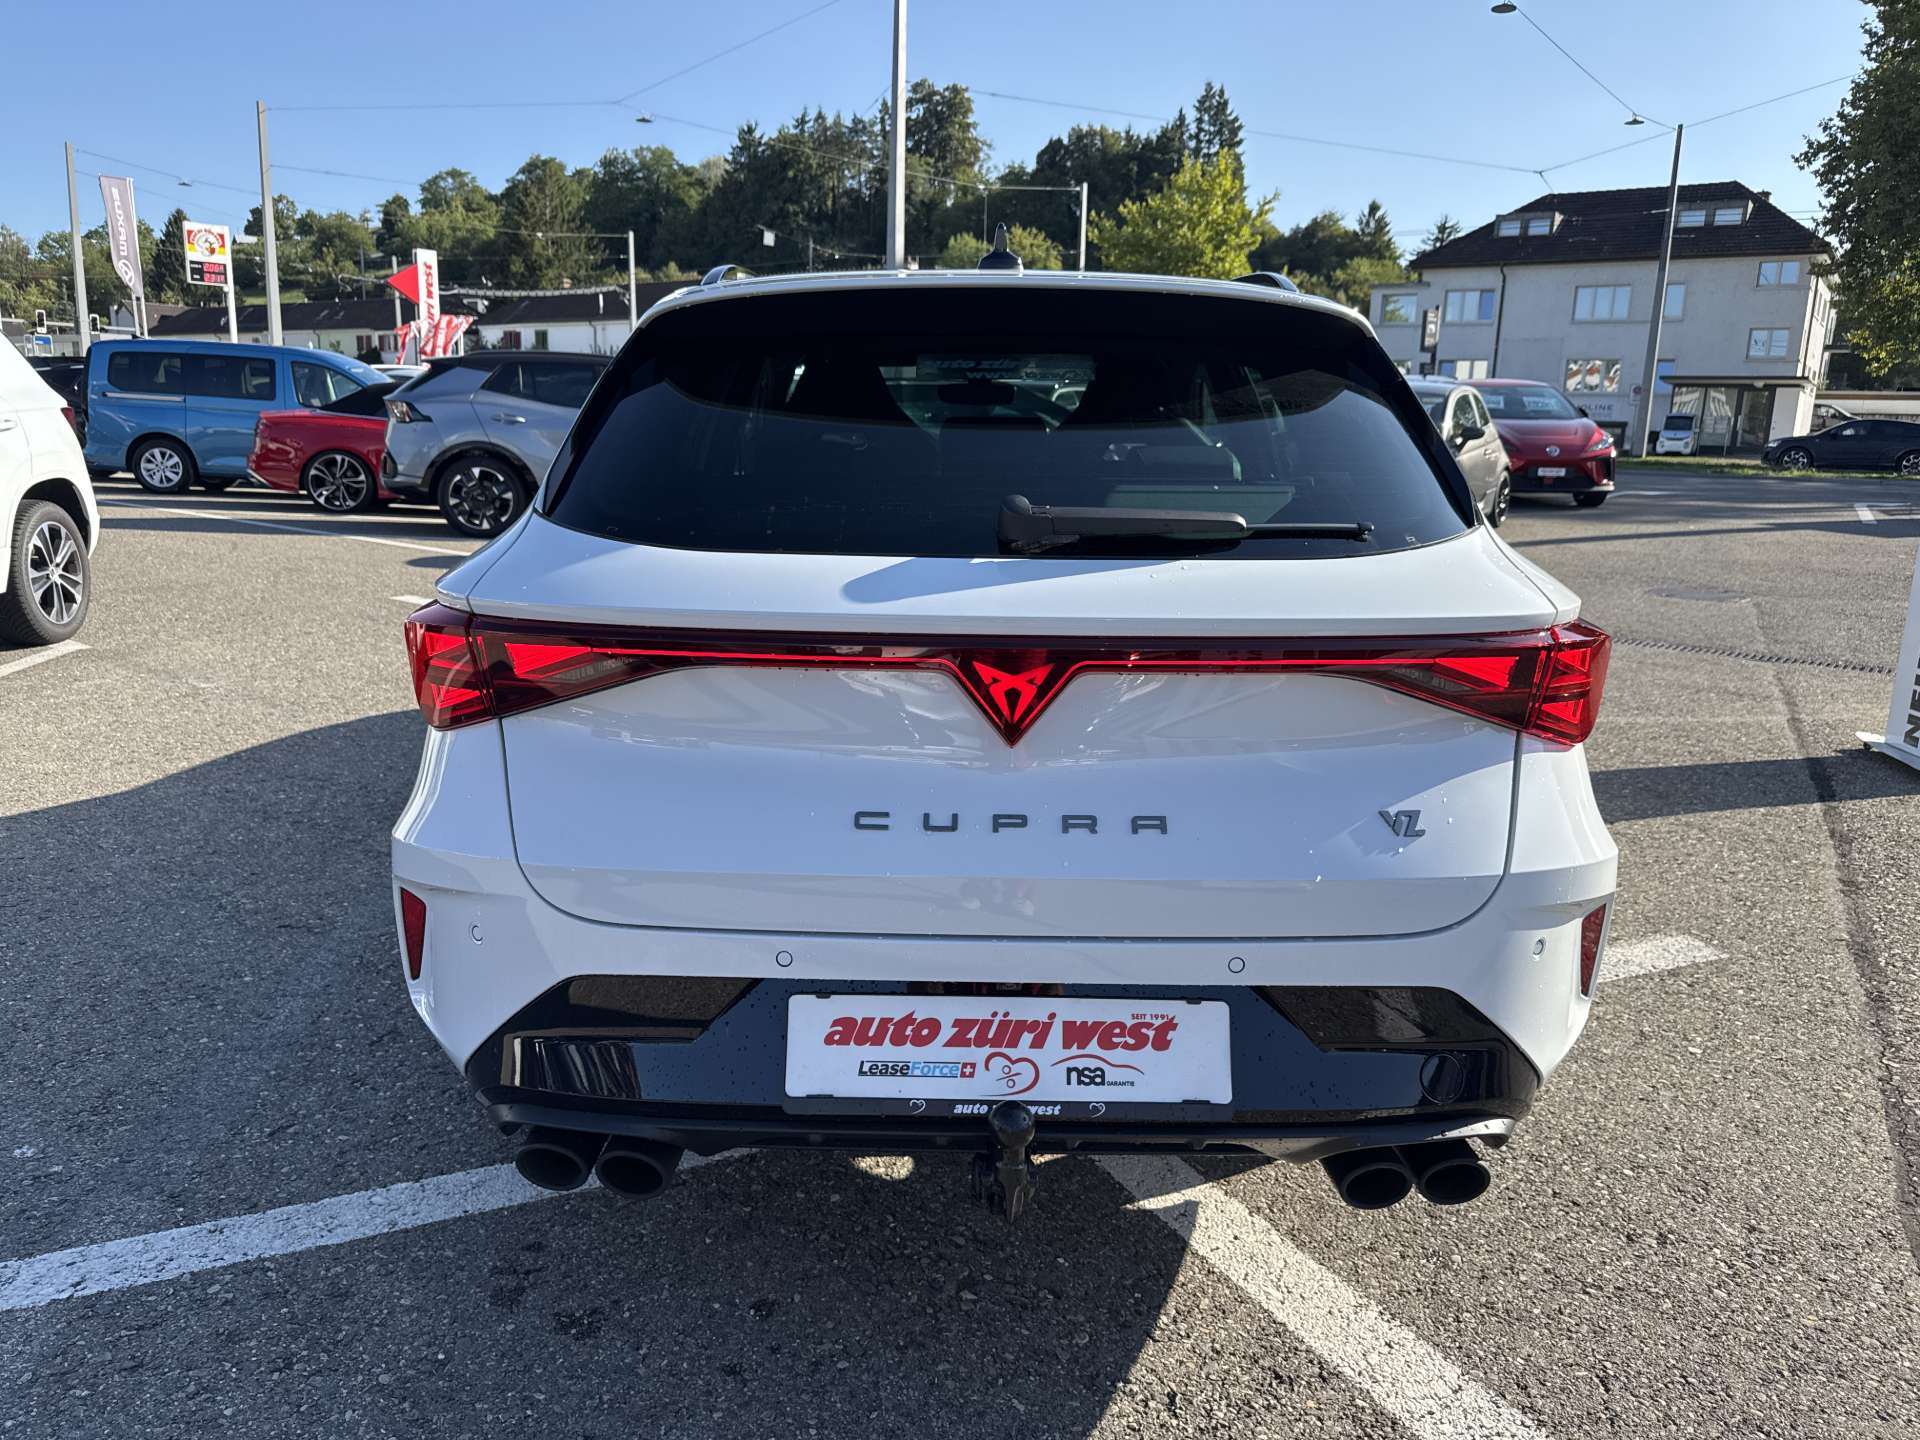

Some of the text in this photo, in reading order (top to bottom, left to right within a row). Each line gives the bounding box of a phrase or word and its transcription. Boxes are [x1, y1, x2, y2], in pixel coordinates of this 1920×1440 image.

[854, 811, 1168, 835] CUPRA
[1378, 809, 1426, 837] VZ
[1149, 1013, 1170, 1021] 1991
[823, 1008, 1179, 1052] auto züri west
[858, 1060, 960, 1077] LeaseForce
[1066, 1066, 1105, 1087] nsa
[953, 1103, 989, 1115] auto
